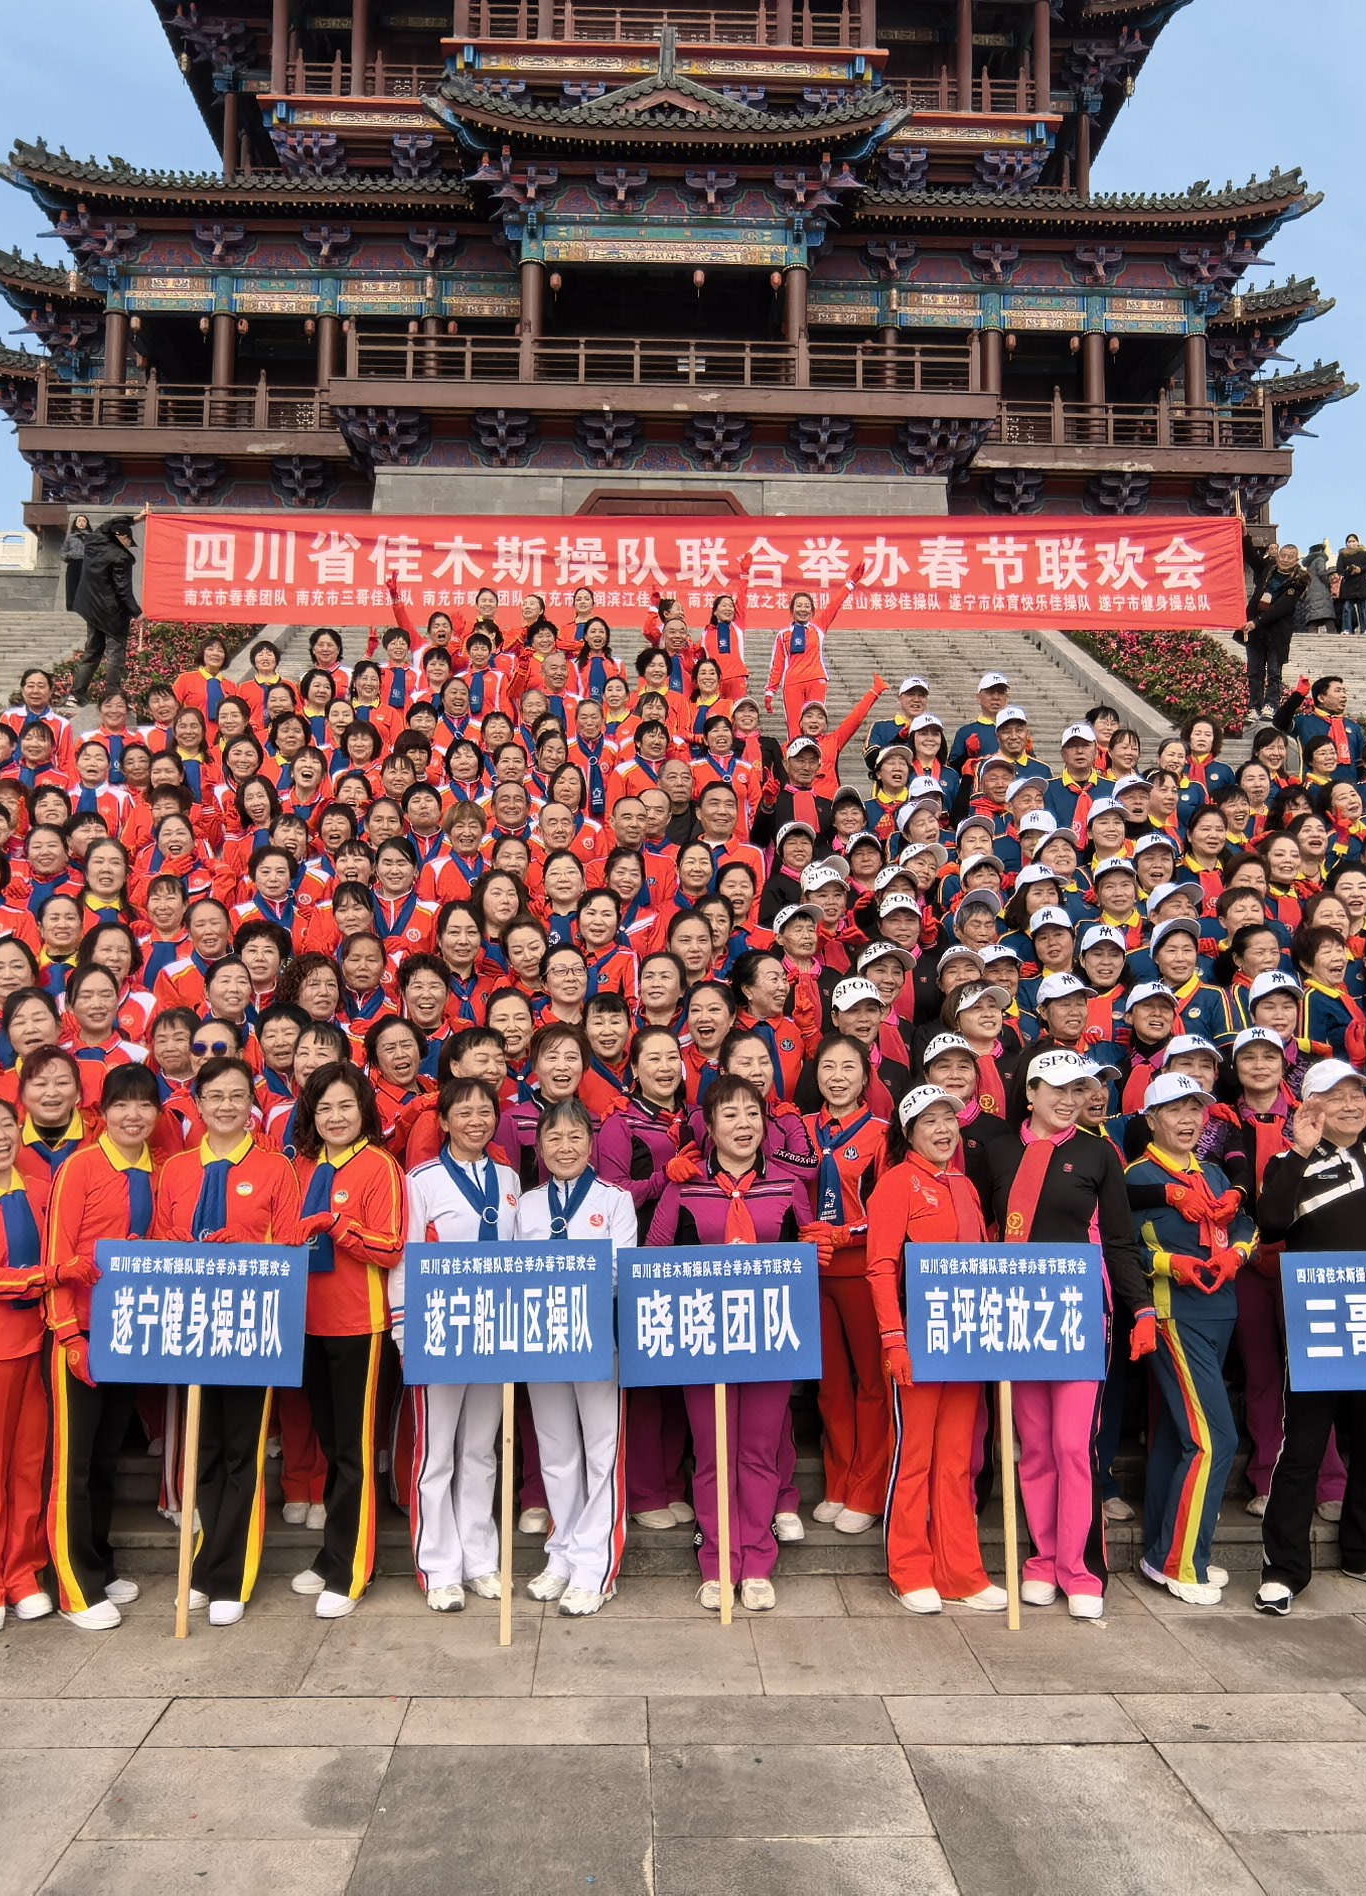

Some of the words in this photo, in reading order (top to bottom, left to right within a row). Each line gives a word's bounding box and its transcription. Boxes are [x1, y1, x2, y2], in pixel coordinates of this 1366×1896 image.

[185, 531, 1206, 591] 四川省佳木斯操队联合举办春节联欢会
[184, 588, 288, 607] 南充市春春团队
[948, 593, 1092, 612] 遂宁市体育快乐佳操队
[1098, 593, 1212, 612] 遂宁市健身操总队
[109, 1255, 291, 1277] 四川省佳木斯操队联合举办春节联欢会
[420, 1255, 597, 1276] 四川省佳木斯操队联合举办春节联欢会
[632, 1257, 803, 1280] 四川省佳木斯操队联合举办春节联欢会
[919, 1257, 1088, 1276] 四川省佳木斯操队联合举办春节联欢会
[109, 1286, 284, 1359] 遂宁健身操总队
[423, 1284, 594, 1357] 遂宁船山区操队
[636, 1284, 801, 1360] 晓晓团队
[925, 1285, 1085, 1355] 高坪绽放之花
